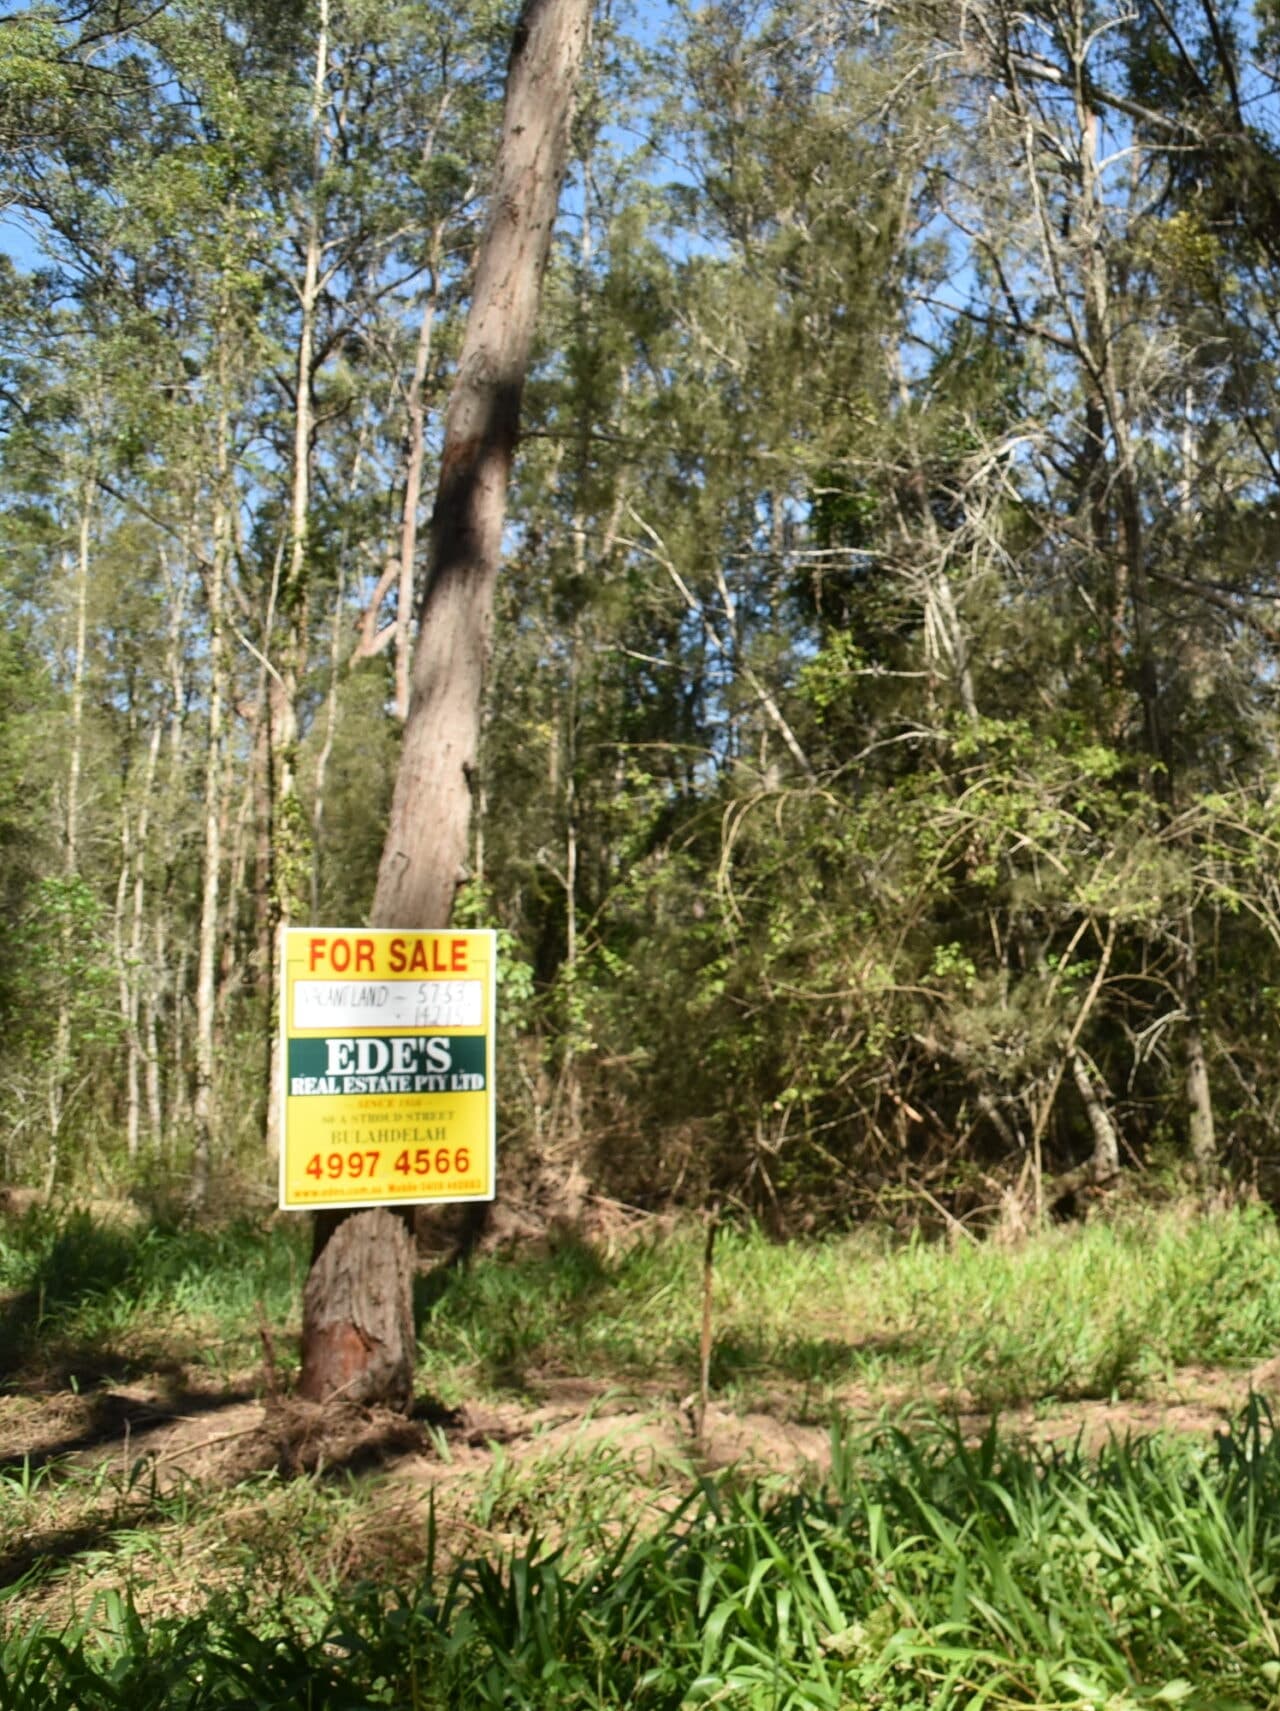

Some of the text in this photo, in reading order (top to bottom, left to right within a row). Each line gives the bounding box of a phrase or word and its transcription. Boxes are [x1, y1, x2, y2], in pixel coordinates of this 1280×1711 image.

[309, 938, 468, 973] FOR SALE
[325, 1037, 452, 1076] EDE'S
[291, 1072, 485, 1095] REAL ESTATE PTY LTD
[406, 1111, 455, 1121] STREET
[331, 1127, 446, 1145] BULAHDELAH
[305, 1148, 470, 1180] 4997 4566
